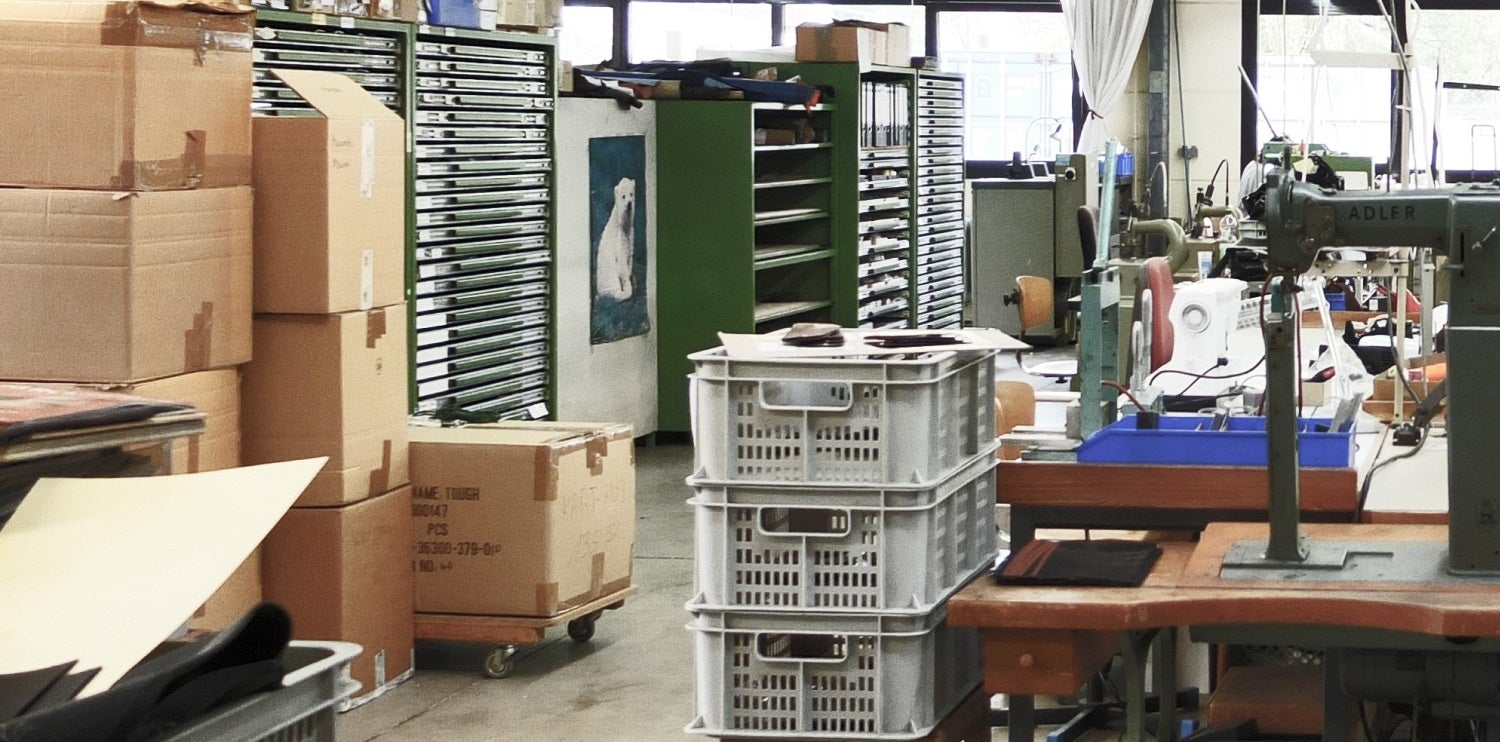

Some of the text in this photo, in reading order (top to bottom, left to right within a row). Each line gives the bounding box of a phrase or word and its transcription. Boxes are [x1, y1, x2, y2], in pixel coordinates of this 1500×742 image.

[1348, 205, 1415, 220] ADLER
[445, 486, 480, 500] TOUGH
[426, 523, 449, 536] PCS
